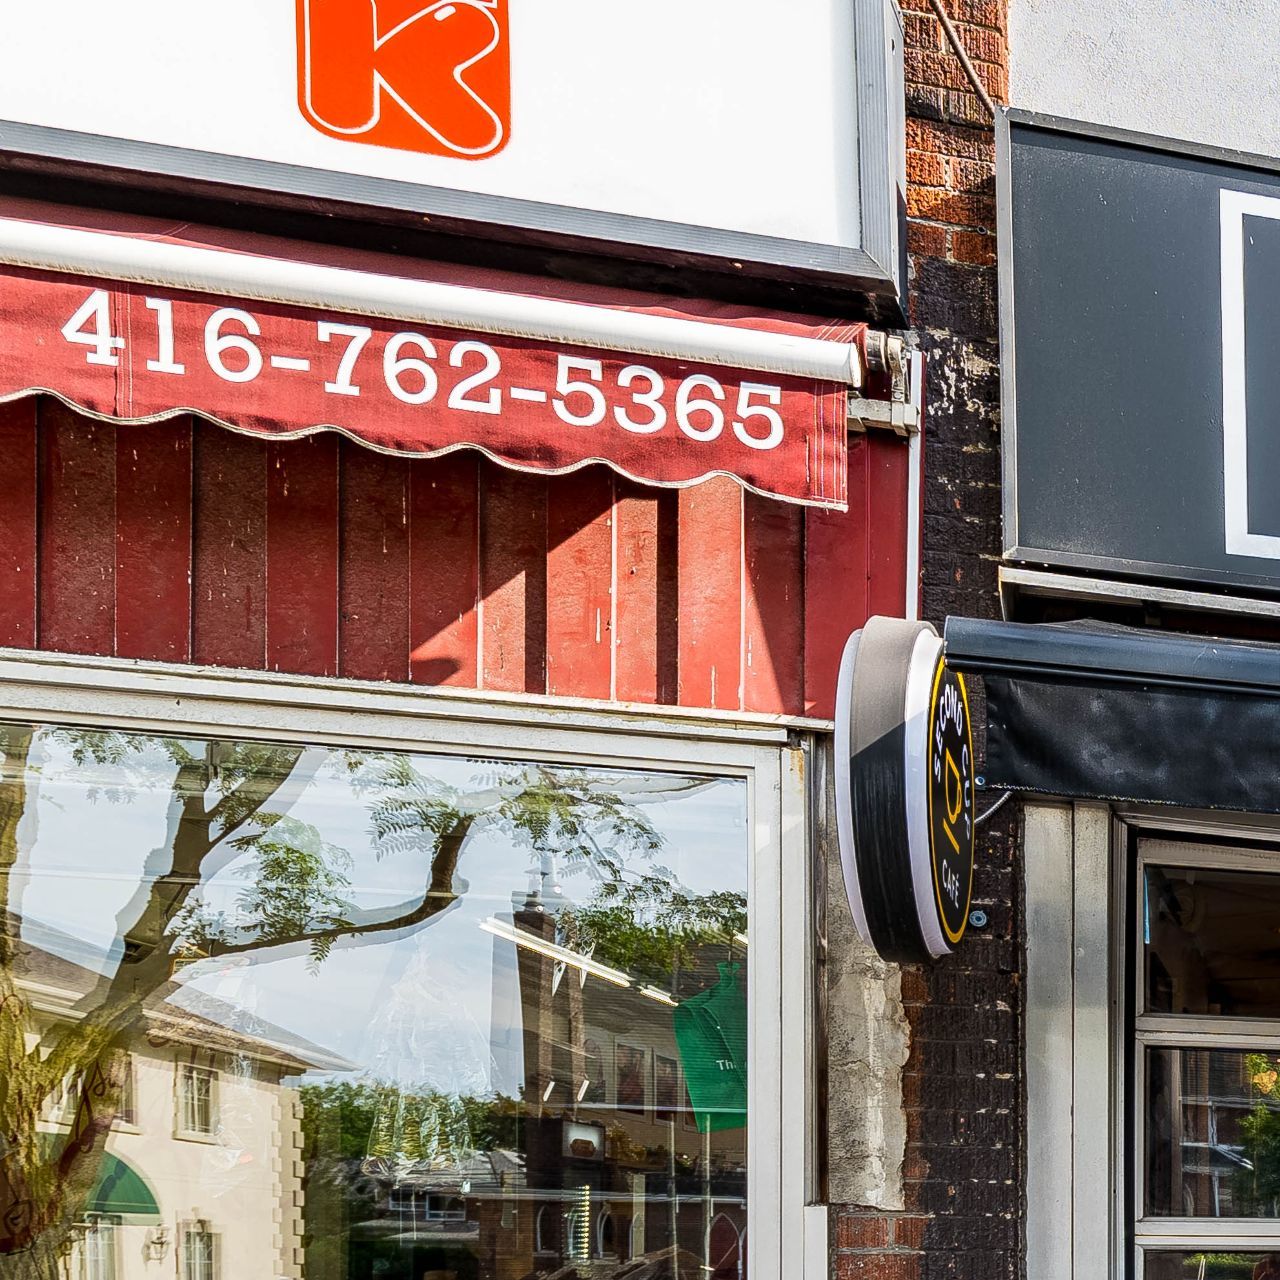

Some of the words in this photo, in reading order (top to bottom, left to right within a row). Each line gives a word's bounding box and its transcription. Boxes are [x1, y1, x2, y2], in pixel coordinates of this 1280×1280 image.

[60, 290, 786, 450] 416-762-5365
[934, 683, 963, 783] SECOND
[960, 744, 972, 840] CUP
[942, 858, 960, 909] CAFÉ
